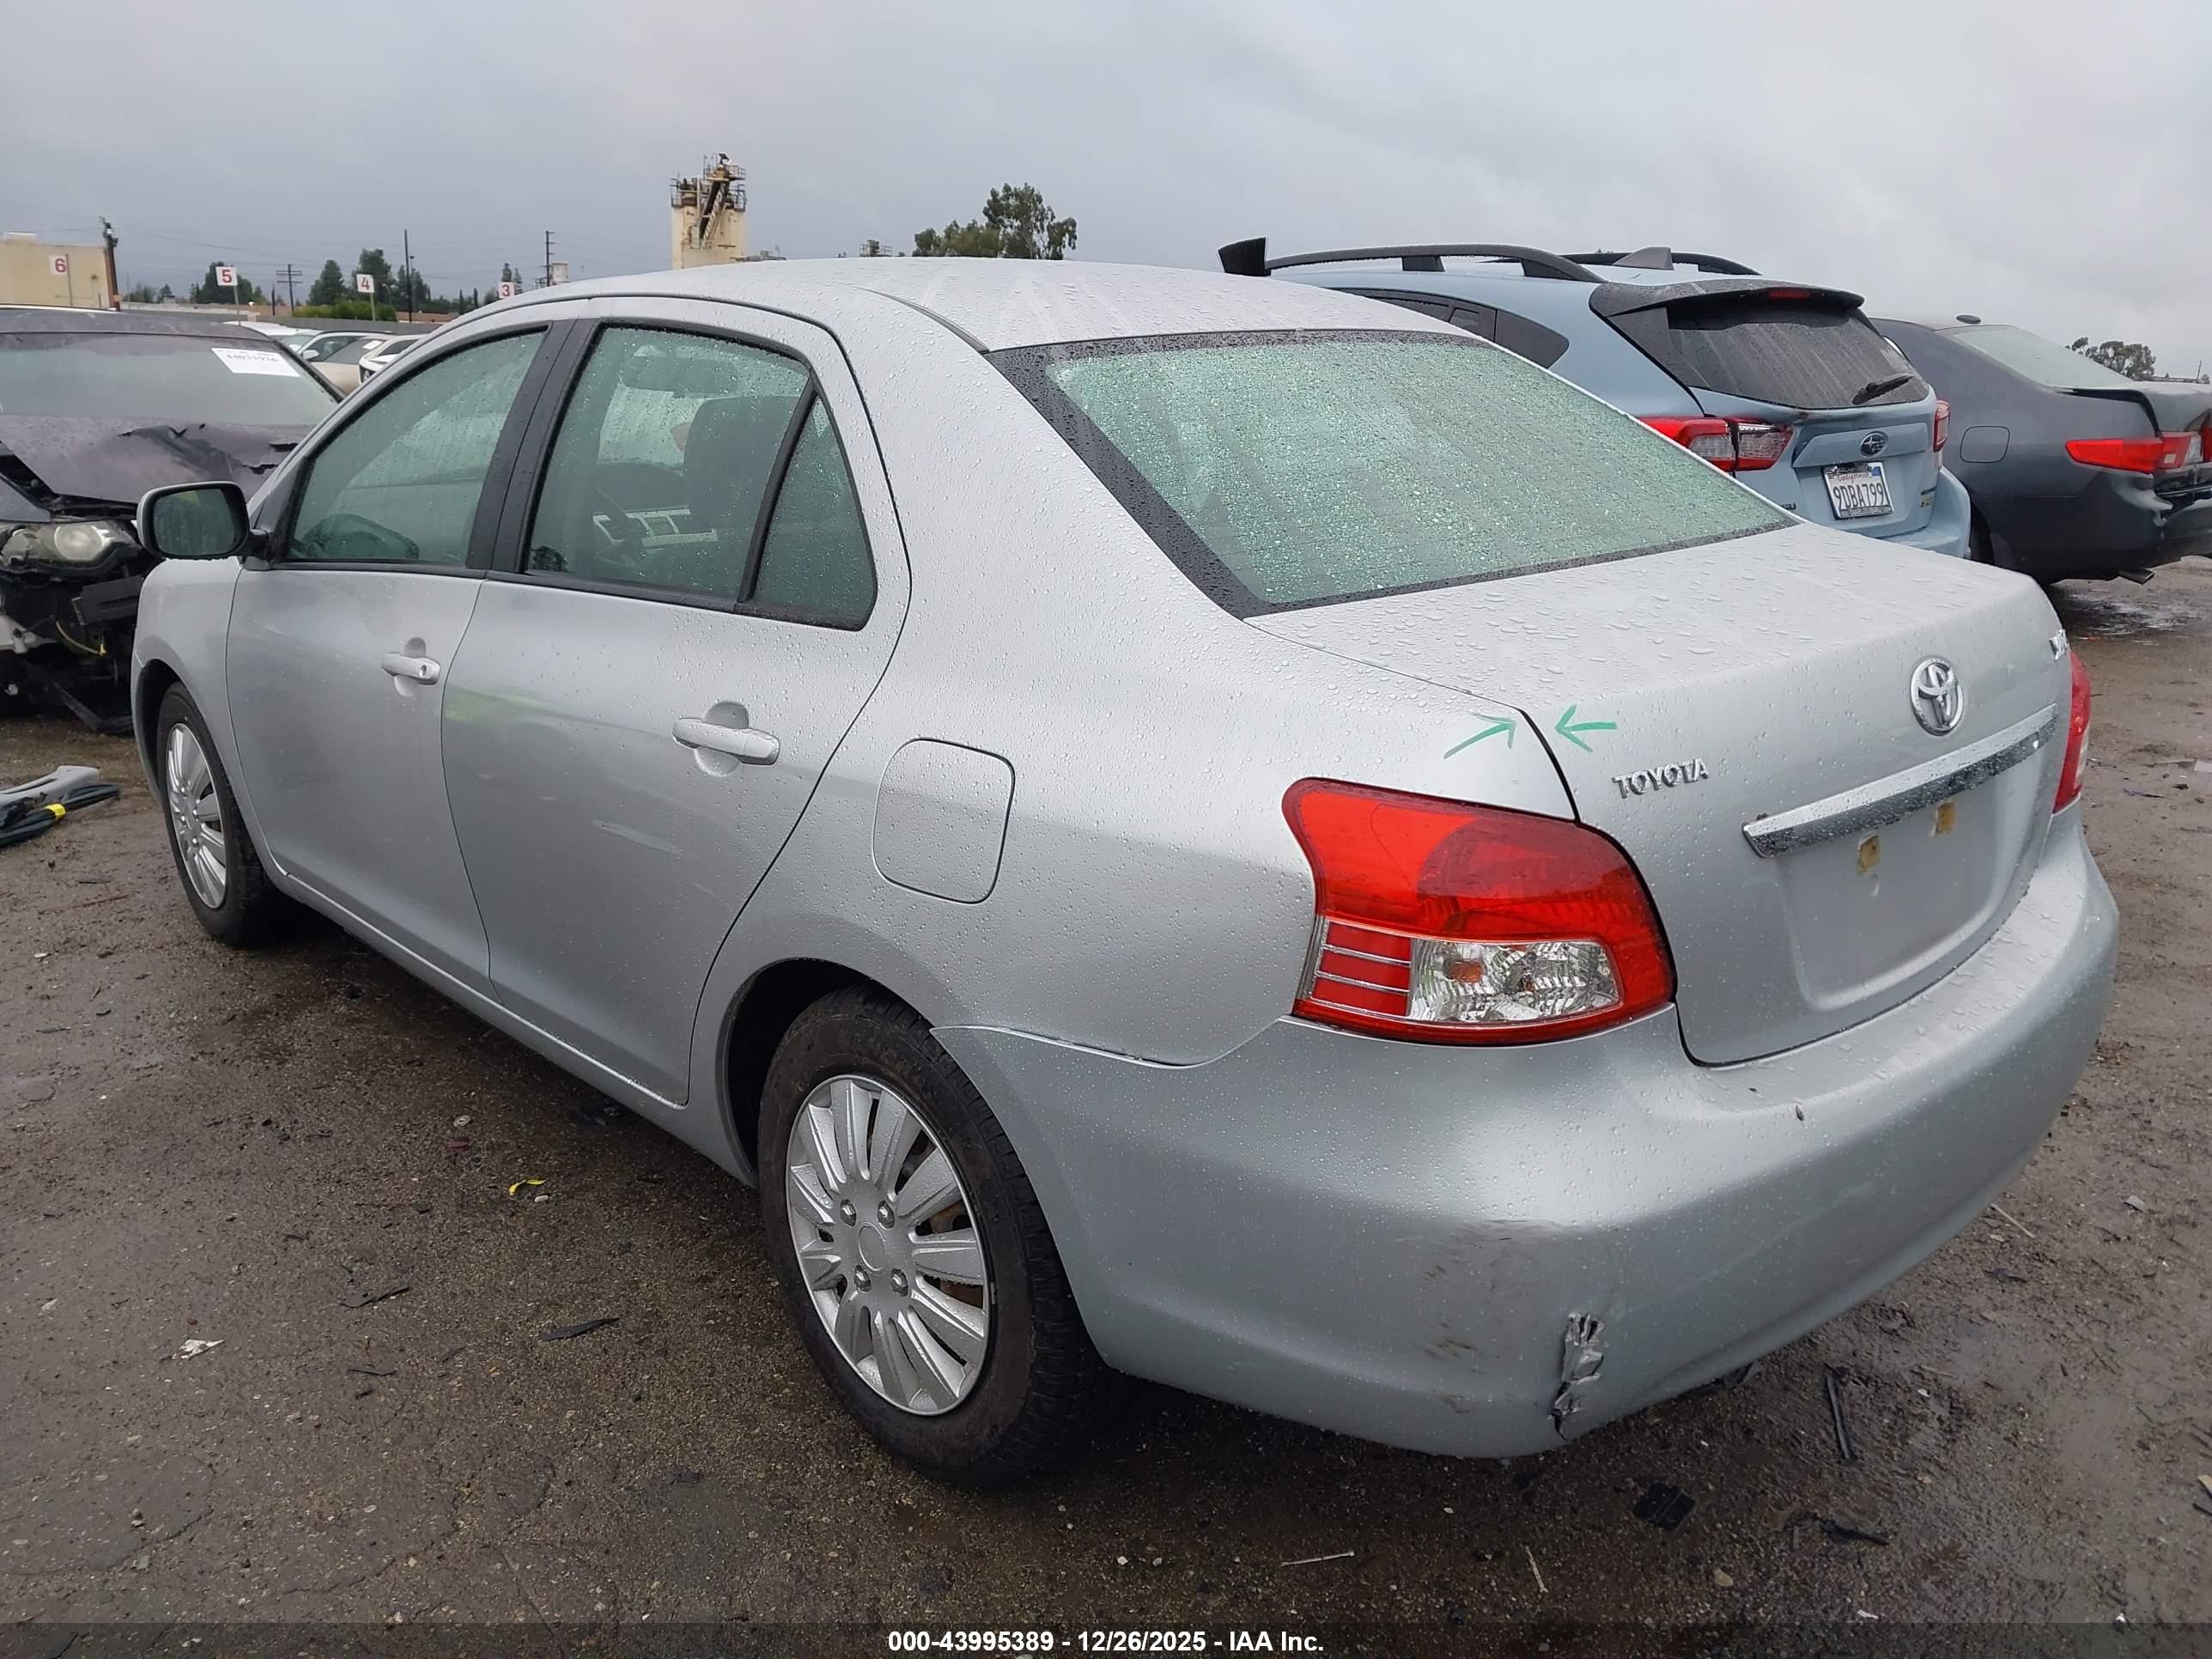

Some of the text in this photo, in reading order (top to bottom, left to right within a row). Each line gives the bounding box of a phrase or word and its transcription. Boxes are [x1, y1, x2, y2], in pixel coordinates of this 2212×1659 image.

[55, 258, 66, 273] 6
[222, 269, 232, 283] 5
[361, 276, 370, 291] 4
[501, 284, 510, 297] 3
[1832, 483, 1885, 511] 9DBA799
[1611, 757, 1711, 799] TOYOTA
